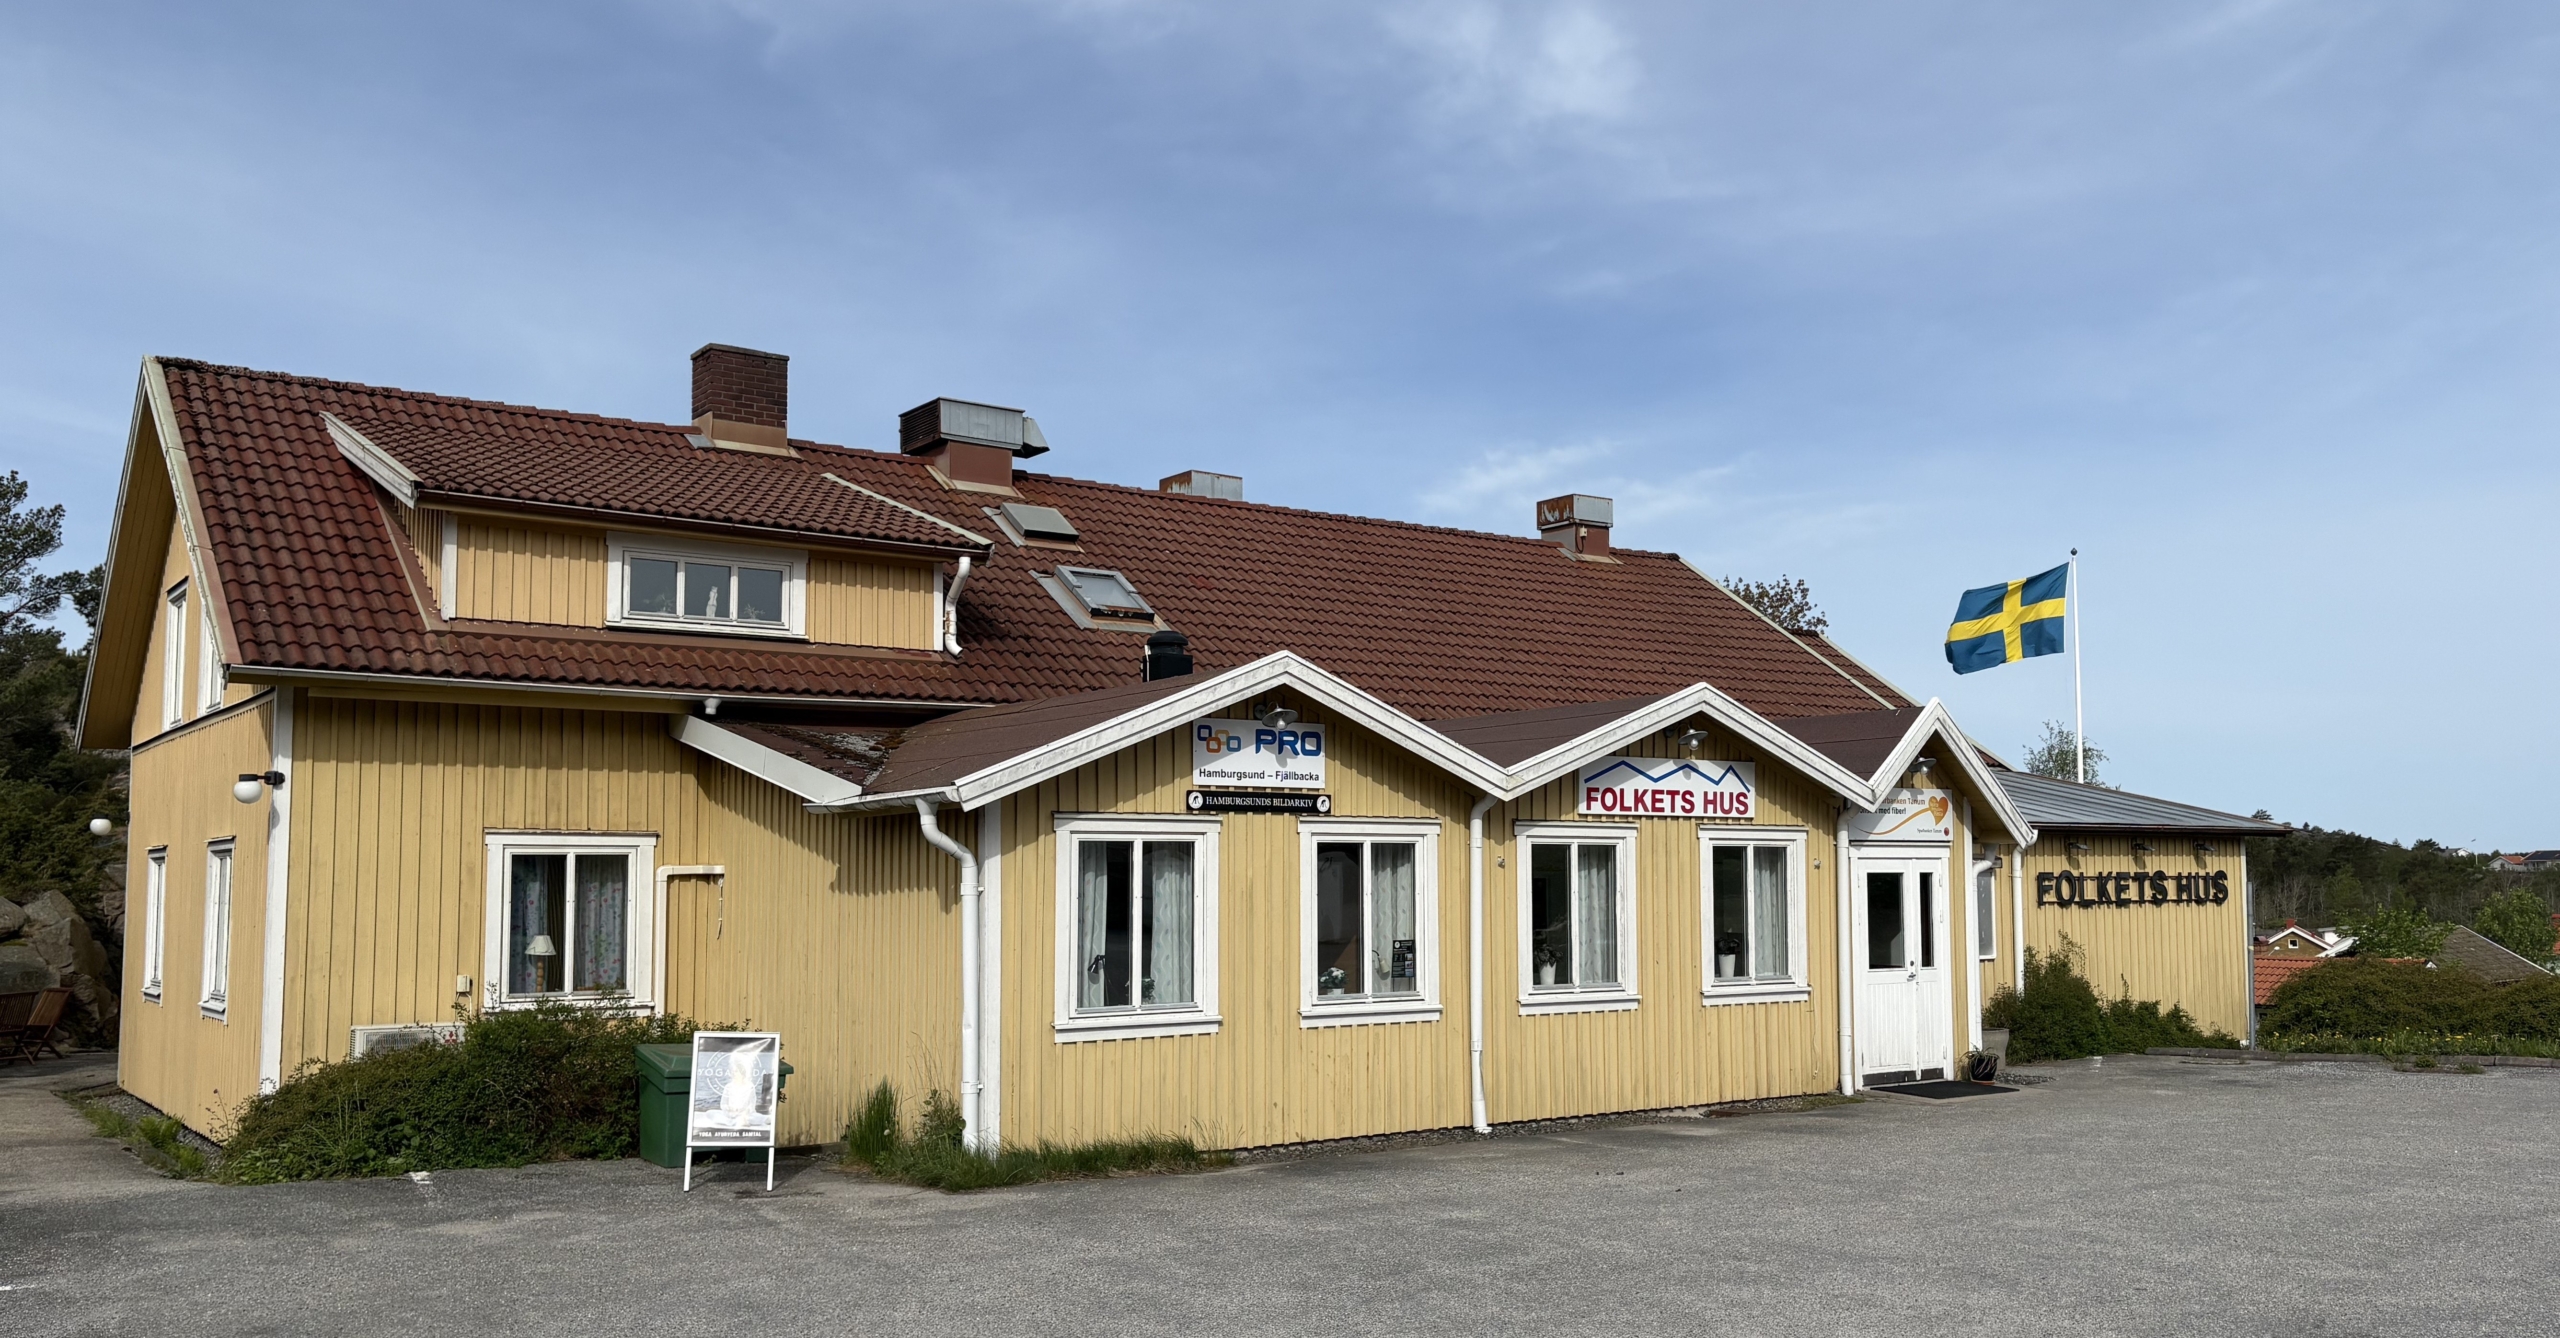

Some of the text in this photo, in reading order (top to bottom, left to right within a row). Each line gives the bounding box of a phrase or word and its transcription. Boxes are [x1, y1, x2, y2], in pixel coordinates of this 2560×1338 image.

[1255, 728, 1321, 756] PRO
[1199, 768, 1265, 780] Hamburgsund
[1275, 770, 1319, 782] Fjällbacka
[1206, 796, 1313, 807] HAMBURGSUNDS BILDARKIV
[1586, 787, 1749, 815] FOLKETS HUS
[2037, 869, 2229, 906] FOLKETS HUS
